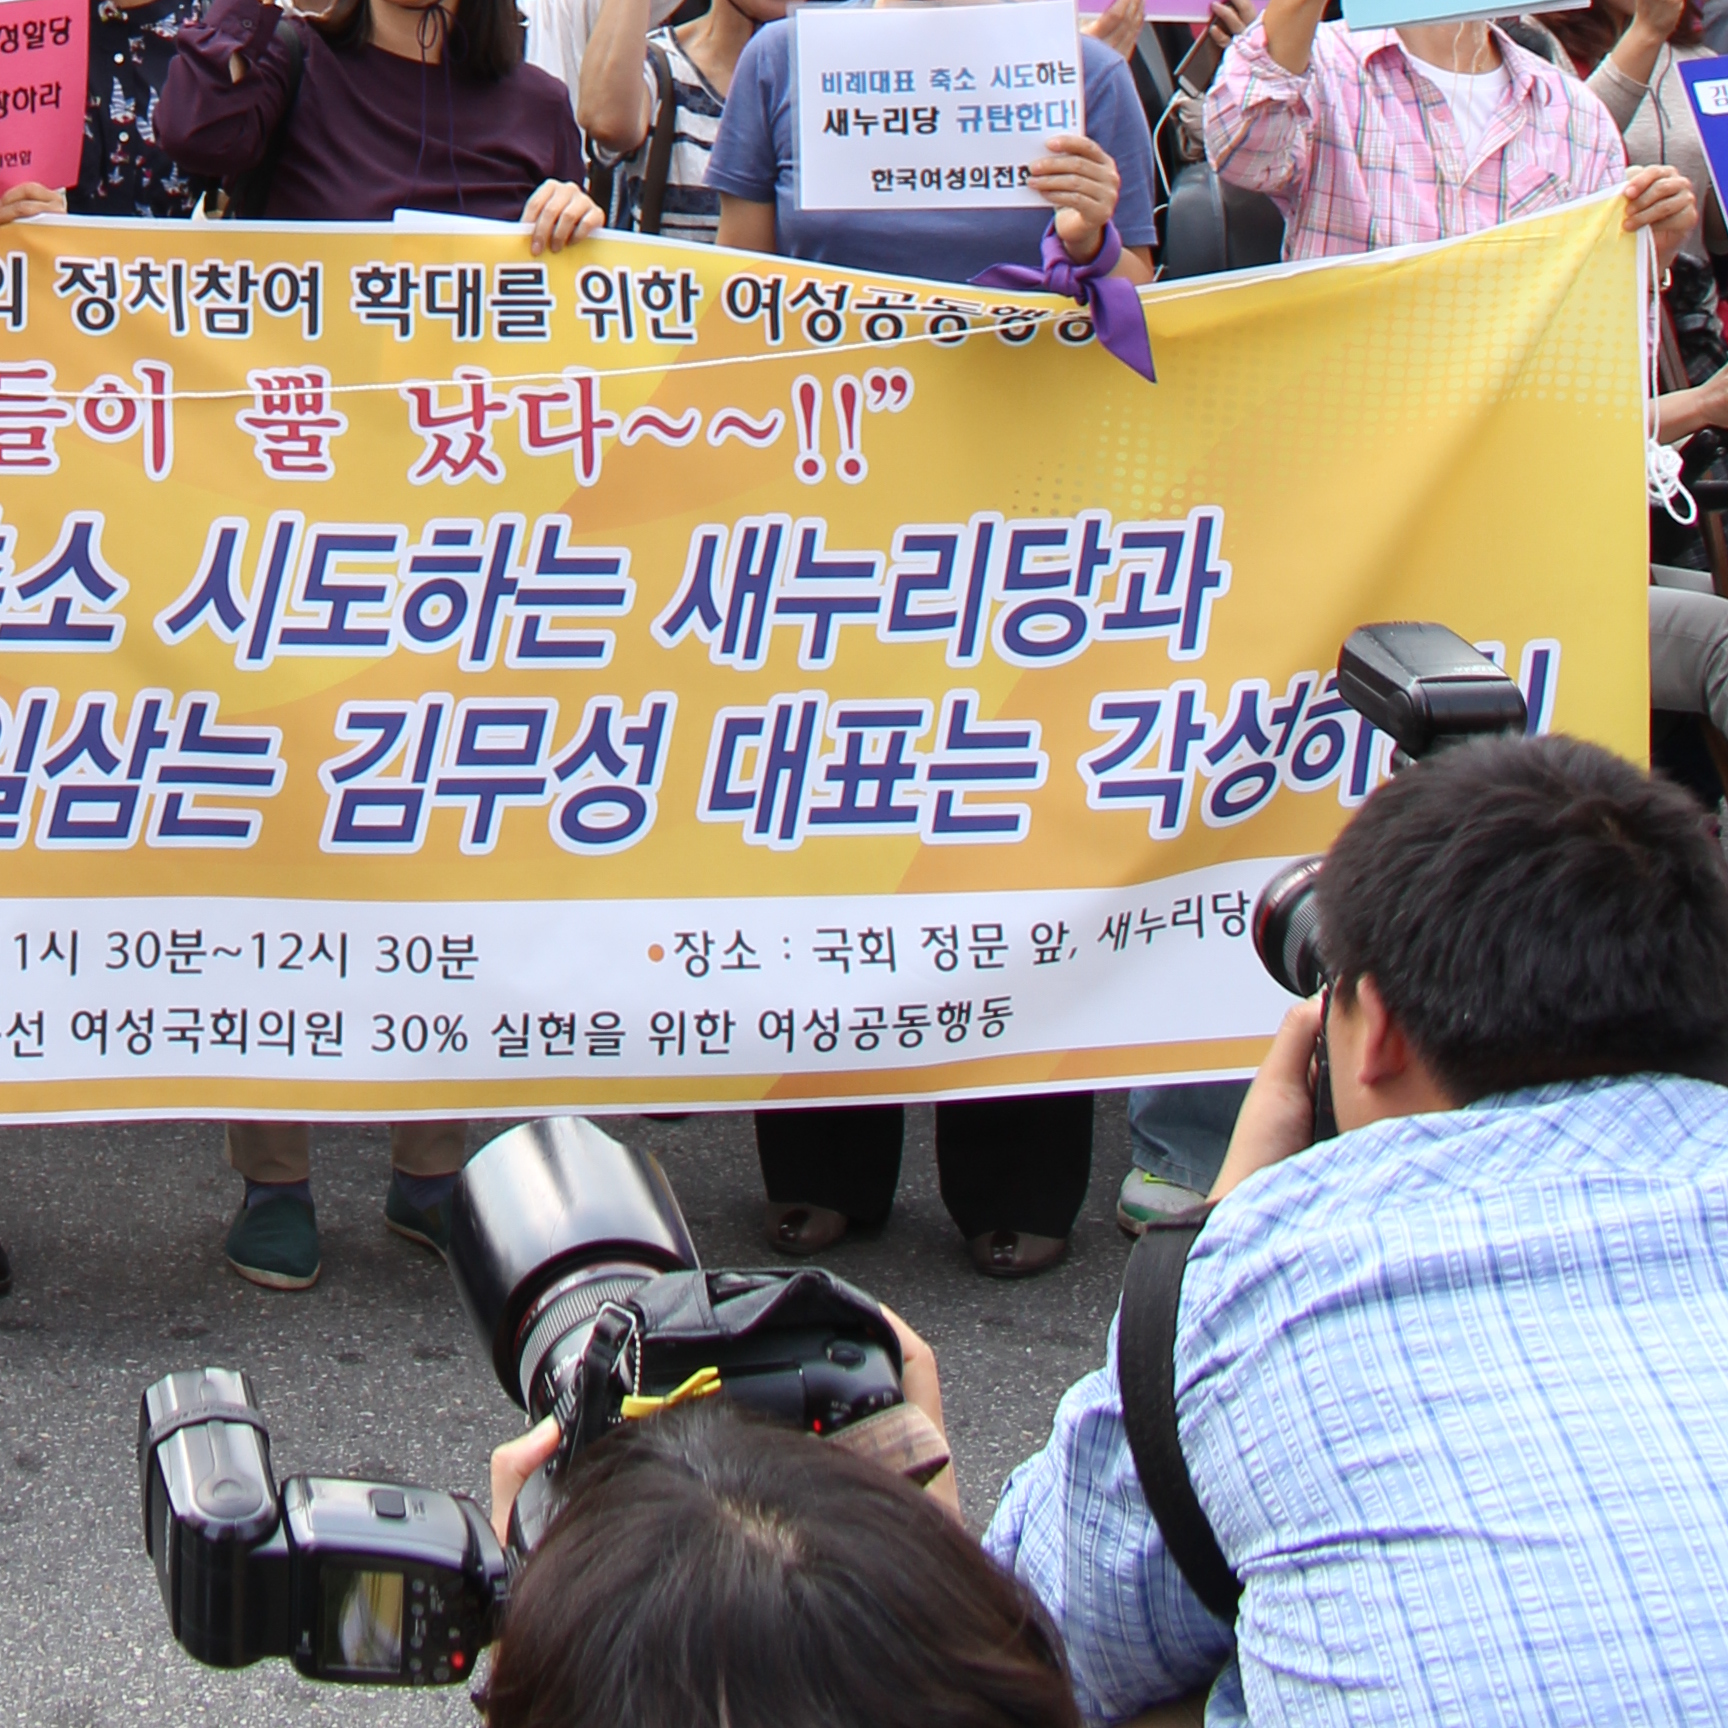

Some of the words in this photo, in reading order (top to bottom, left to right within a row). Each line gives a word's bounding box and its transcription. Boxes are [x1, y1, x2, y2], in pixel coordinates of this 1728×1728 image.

[821, 69, 916, 96] 비례대표
[928, 67, 977, 93] 축소
[990, 60, 1078, 90] 시도하는
[823, 105, 941, 137] 새누리당
[956, 98, 1078, 134] 규탄한다!
[57, 258, 321, 339] 정치참여
[353, 264, 552, 342] 확대를
[581, 268, 699, 343] 위한
[244, 370, 343, 477] 뿔
[168, 522, 625, 660] 시도하는
[664, 516, 1223, 657] 새누리당과
[330, 701, 669, 847] 김무성
[710, 701, 1042, 841] 대표는
[375, 932, 481, 981] 30분
[812, 927, 899, 977] 국회
[919, 921, 1008, 975] 정문
[1096, 894, 1251, 953] 새누리당
[70, 1008, 345, 1058] 여성국회의원
[370, 1011, 470, 1055] 30%
[491, 1007, 626, 1058] 실현을
[647, 1007, 736, 1056] 위한
[757, 995, 1014, 1052] 여성공동행동
